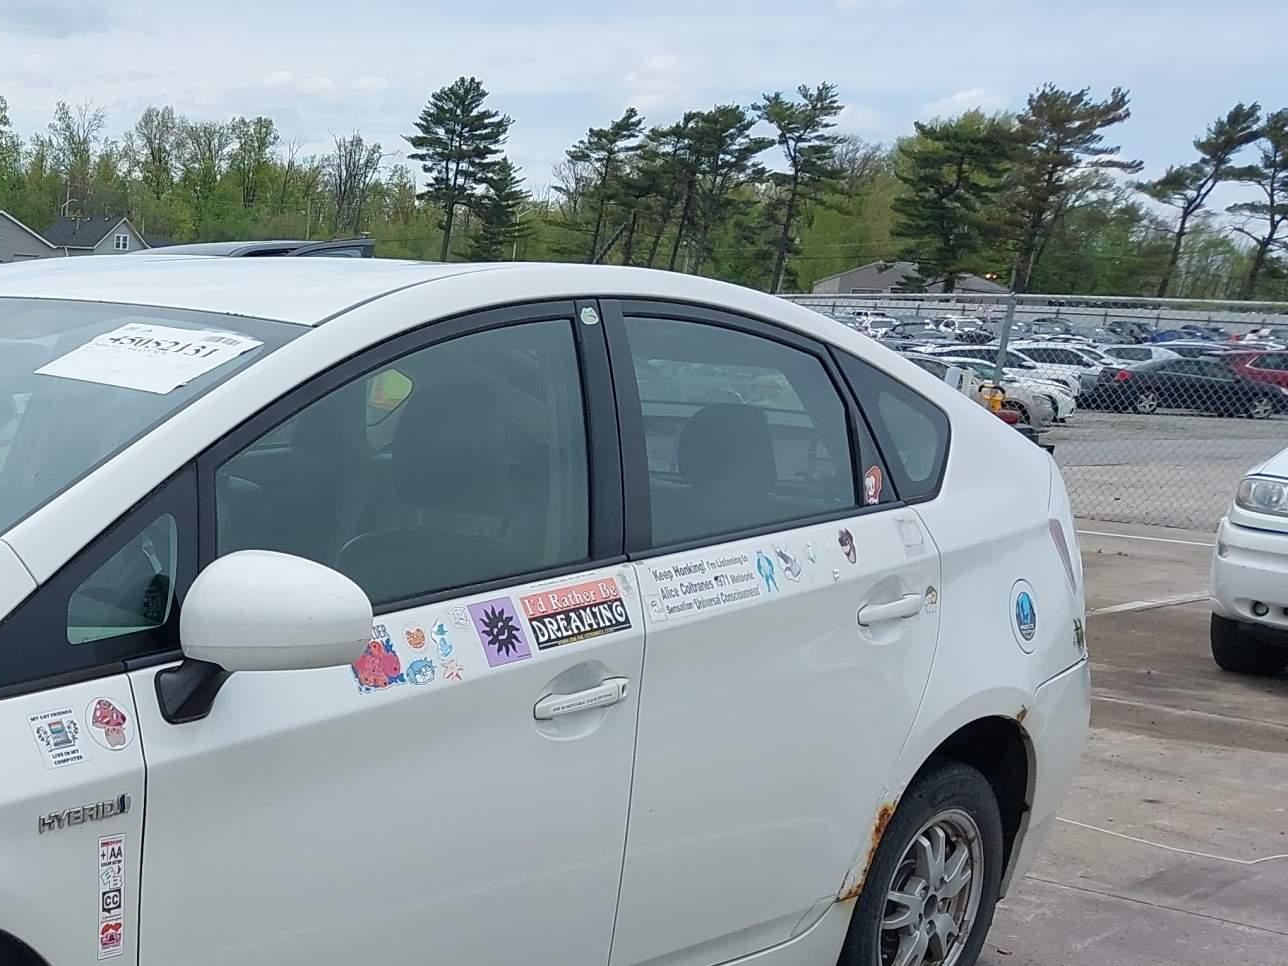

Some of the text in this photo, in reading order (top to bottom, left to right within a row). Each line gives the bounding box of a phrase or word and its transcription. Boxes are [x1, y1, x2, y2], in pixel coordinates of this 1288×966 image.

[672, 560, 707, 577] Honking!
[524, 582, 617, 615] I'd Rather Be
[660, 587, 680, 600] Alice
[714, 574, 731, 588] 1971
[531, 601, 626, 642] DREAMING
[54, 755, 83, 765] COMPUTER
[39, 799, 114, 834] HYBRID
[105, 894, 118, 906] CC
